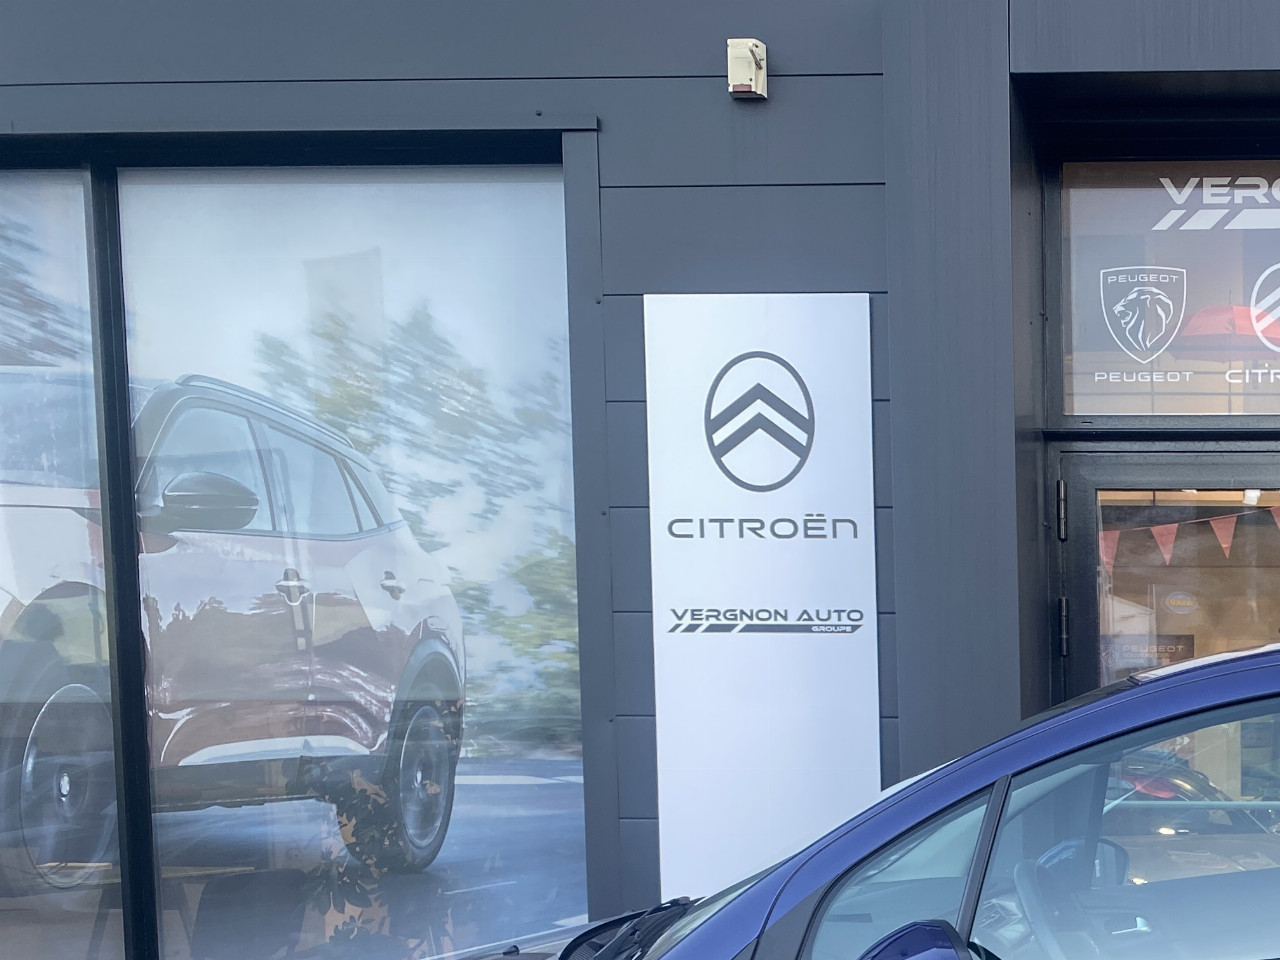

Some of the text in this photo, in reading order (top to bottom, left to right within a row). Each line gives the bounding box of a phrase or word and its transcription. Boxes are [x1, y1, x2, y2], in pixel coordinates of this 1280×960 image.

[1107, 273, 1180, 285] PEUGEOT
[1094, 371, 1195, 383] PEUGEOT
[669, 608, 865, 622] VERGNON AUTO
[810, 625, 853, 633] GROUPE
